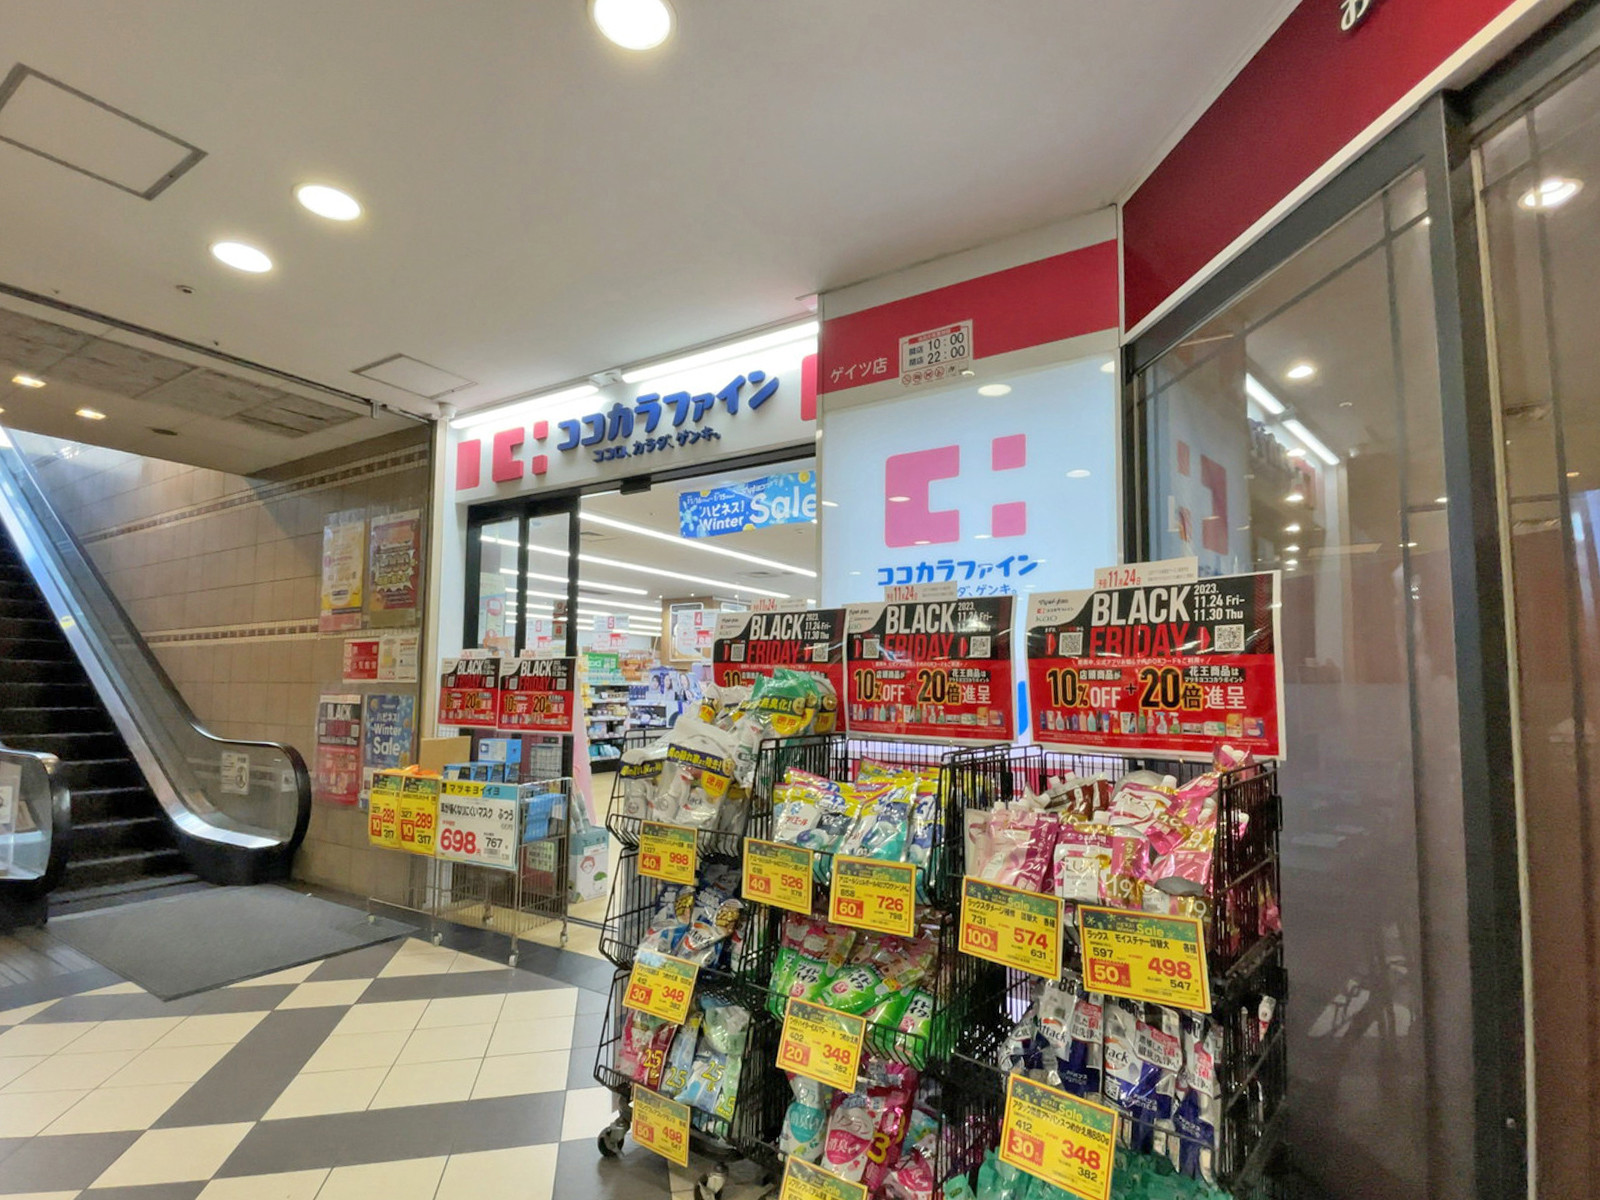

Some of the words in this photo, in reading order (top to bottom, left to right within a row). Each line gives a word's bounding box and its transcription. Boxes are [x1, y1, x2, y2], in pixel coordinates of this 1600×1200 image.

[831, 357, 888, 384] ゲイツ店
[556, 370, 780, 451] ココカラファイン
[700, 515, 744, 532] Winter
[750, 486, 816, 523] Sale
[878, 555, 1038, 587] ココカラファイン
[1091, 585, 1191, 626] BLACK
[1194, 594, 1223, 608] 11.24
[885, 602, 957, 634] BLACK
[1193, 608, 1223, 621] 11.30
[1225, 609, 1244, 620] Thu
[749, 614, 806, 640] BLACK
[884, 633, 954, 661] FRIDAY
[1089, 623, 1191, 658] FRIDAY
[747, 640, 802, 664] FRIDAY
[457, 660, 484, 675] BLACK
[521, 661, 553, 676] BLACK
[373, 722, 402, 735] Winter
[373, 737, 400, 755] Sale
[415, 812, 433, 829] 289
[417, 834, 431, 845] 317
[441, 828, 476, 854] 698
[485, 837, 503, 848] 767
[643, 857, 656, 869] 40
[669, 852, 689, 866] 998
[751, 878, 765, 891] 40
[781, 874, 803, 890] 526
[840, 902, 857, 916] 60
[877, 895, 903, 912] 726
[971, 914, 987, 926] 731
[1014, 927, 1048, 949] 574
[1087, 930, 1109, 941] ラックス
[1136, 923, 1165, 938] Sale
[967, 928, 991, 947] 100
[1030, 949, 1047, 959] 631
[1093, 947, 1113, 958] 597
[1148, 957, 1192, 980] 498
[1094, 964, 1120, 983] 50
[1170, 979, 1191, 991] 547
[632, 988, 646, 1001] 30
[662, 985, 685, 1003] 348
[786, 1046, 803, 1062] 20
[823, 1044, 851, 1065] 348
[1059, 1104, 1083, 1123] Sale
[663, 1126, 682, 1144] 498
[1016, 1119, 1032, 1133] 412
[1062, 1140, 1101, 1170] 348
[1011, 1136, 1034, 1158] 30
[1077, 1167, 1098, 1182] 382
